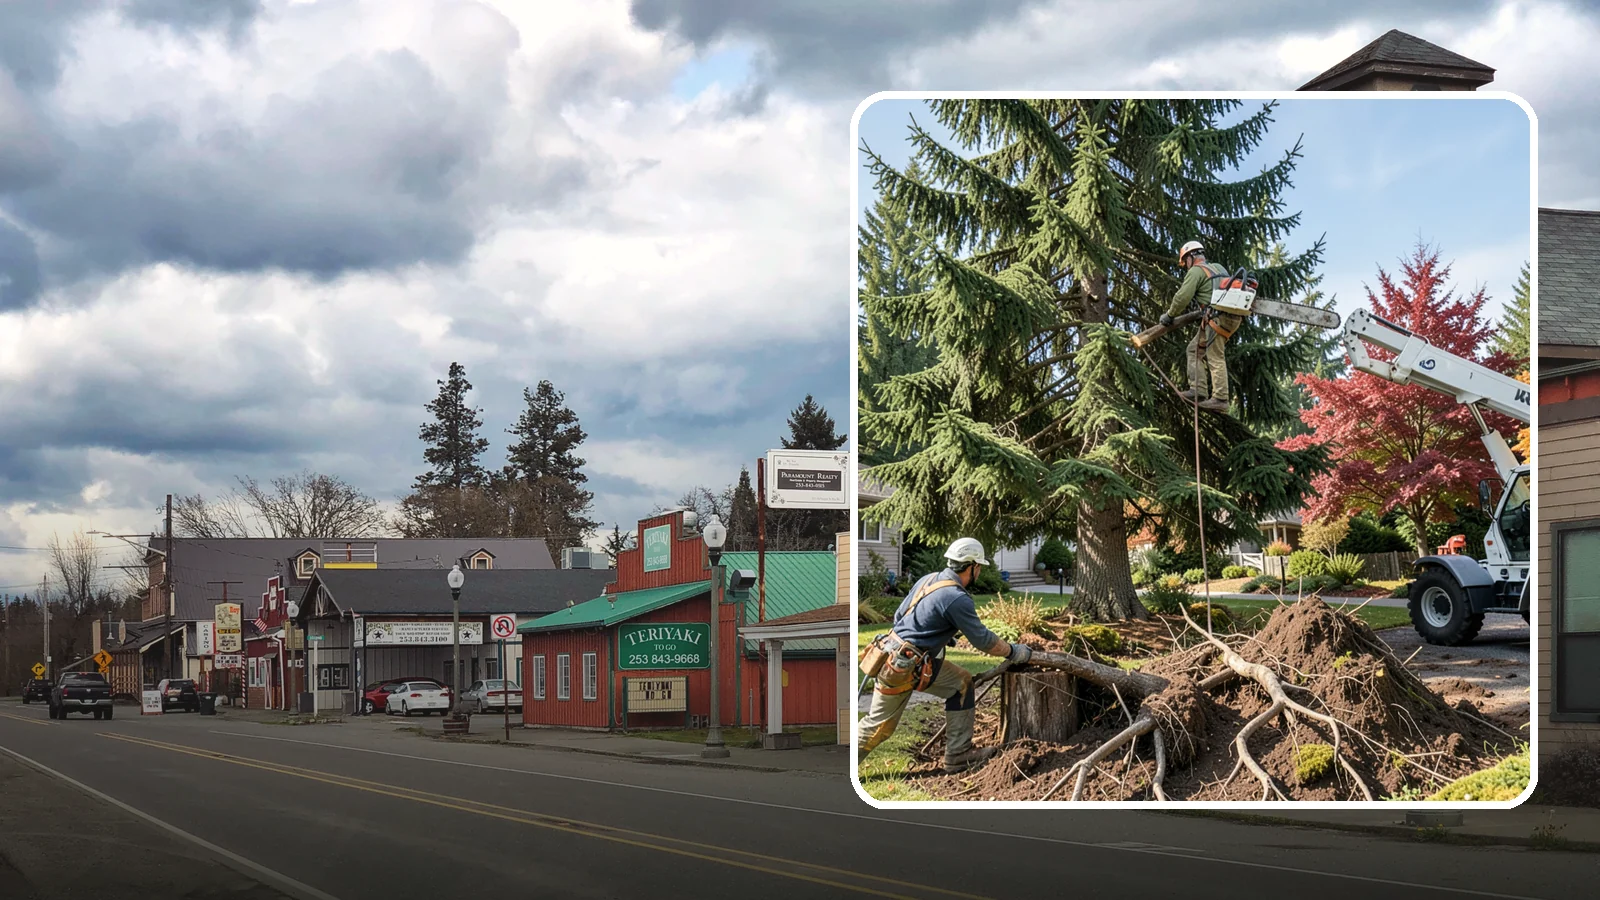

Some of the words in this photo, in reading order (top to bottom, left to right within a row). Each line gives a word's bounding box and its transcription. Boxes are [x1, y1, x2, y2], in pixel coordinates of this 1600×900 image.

[624, 627, 702, 646] TERIYAKI
[629, 654, 648, 665] 253
[651, 653, 700, 664] 843-9668
